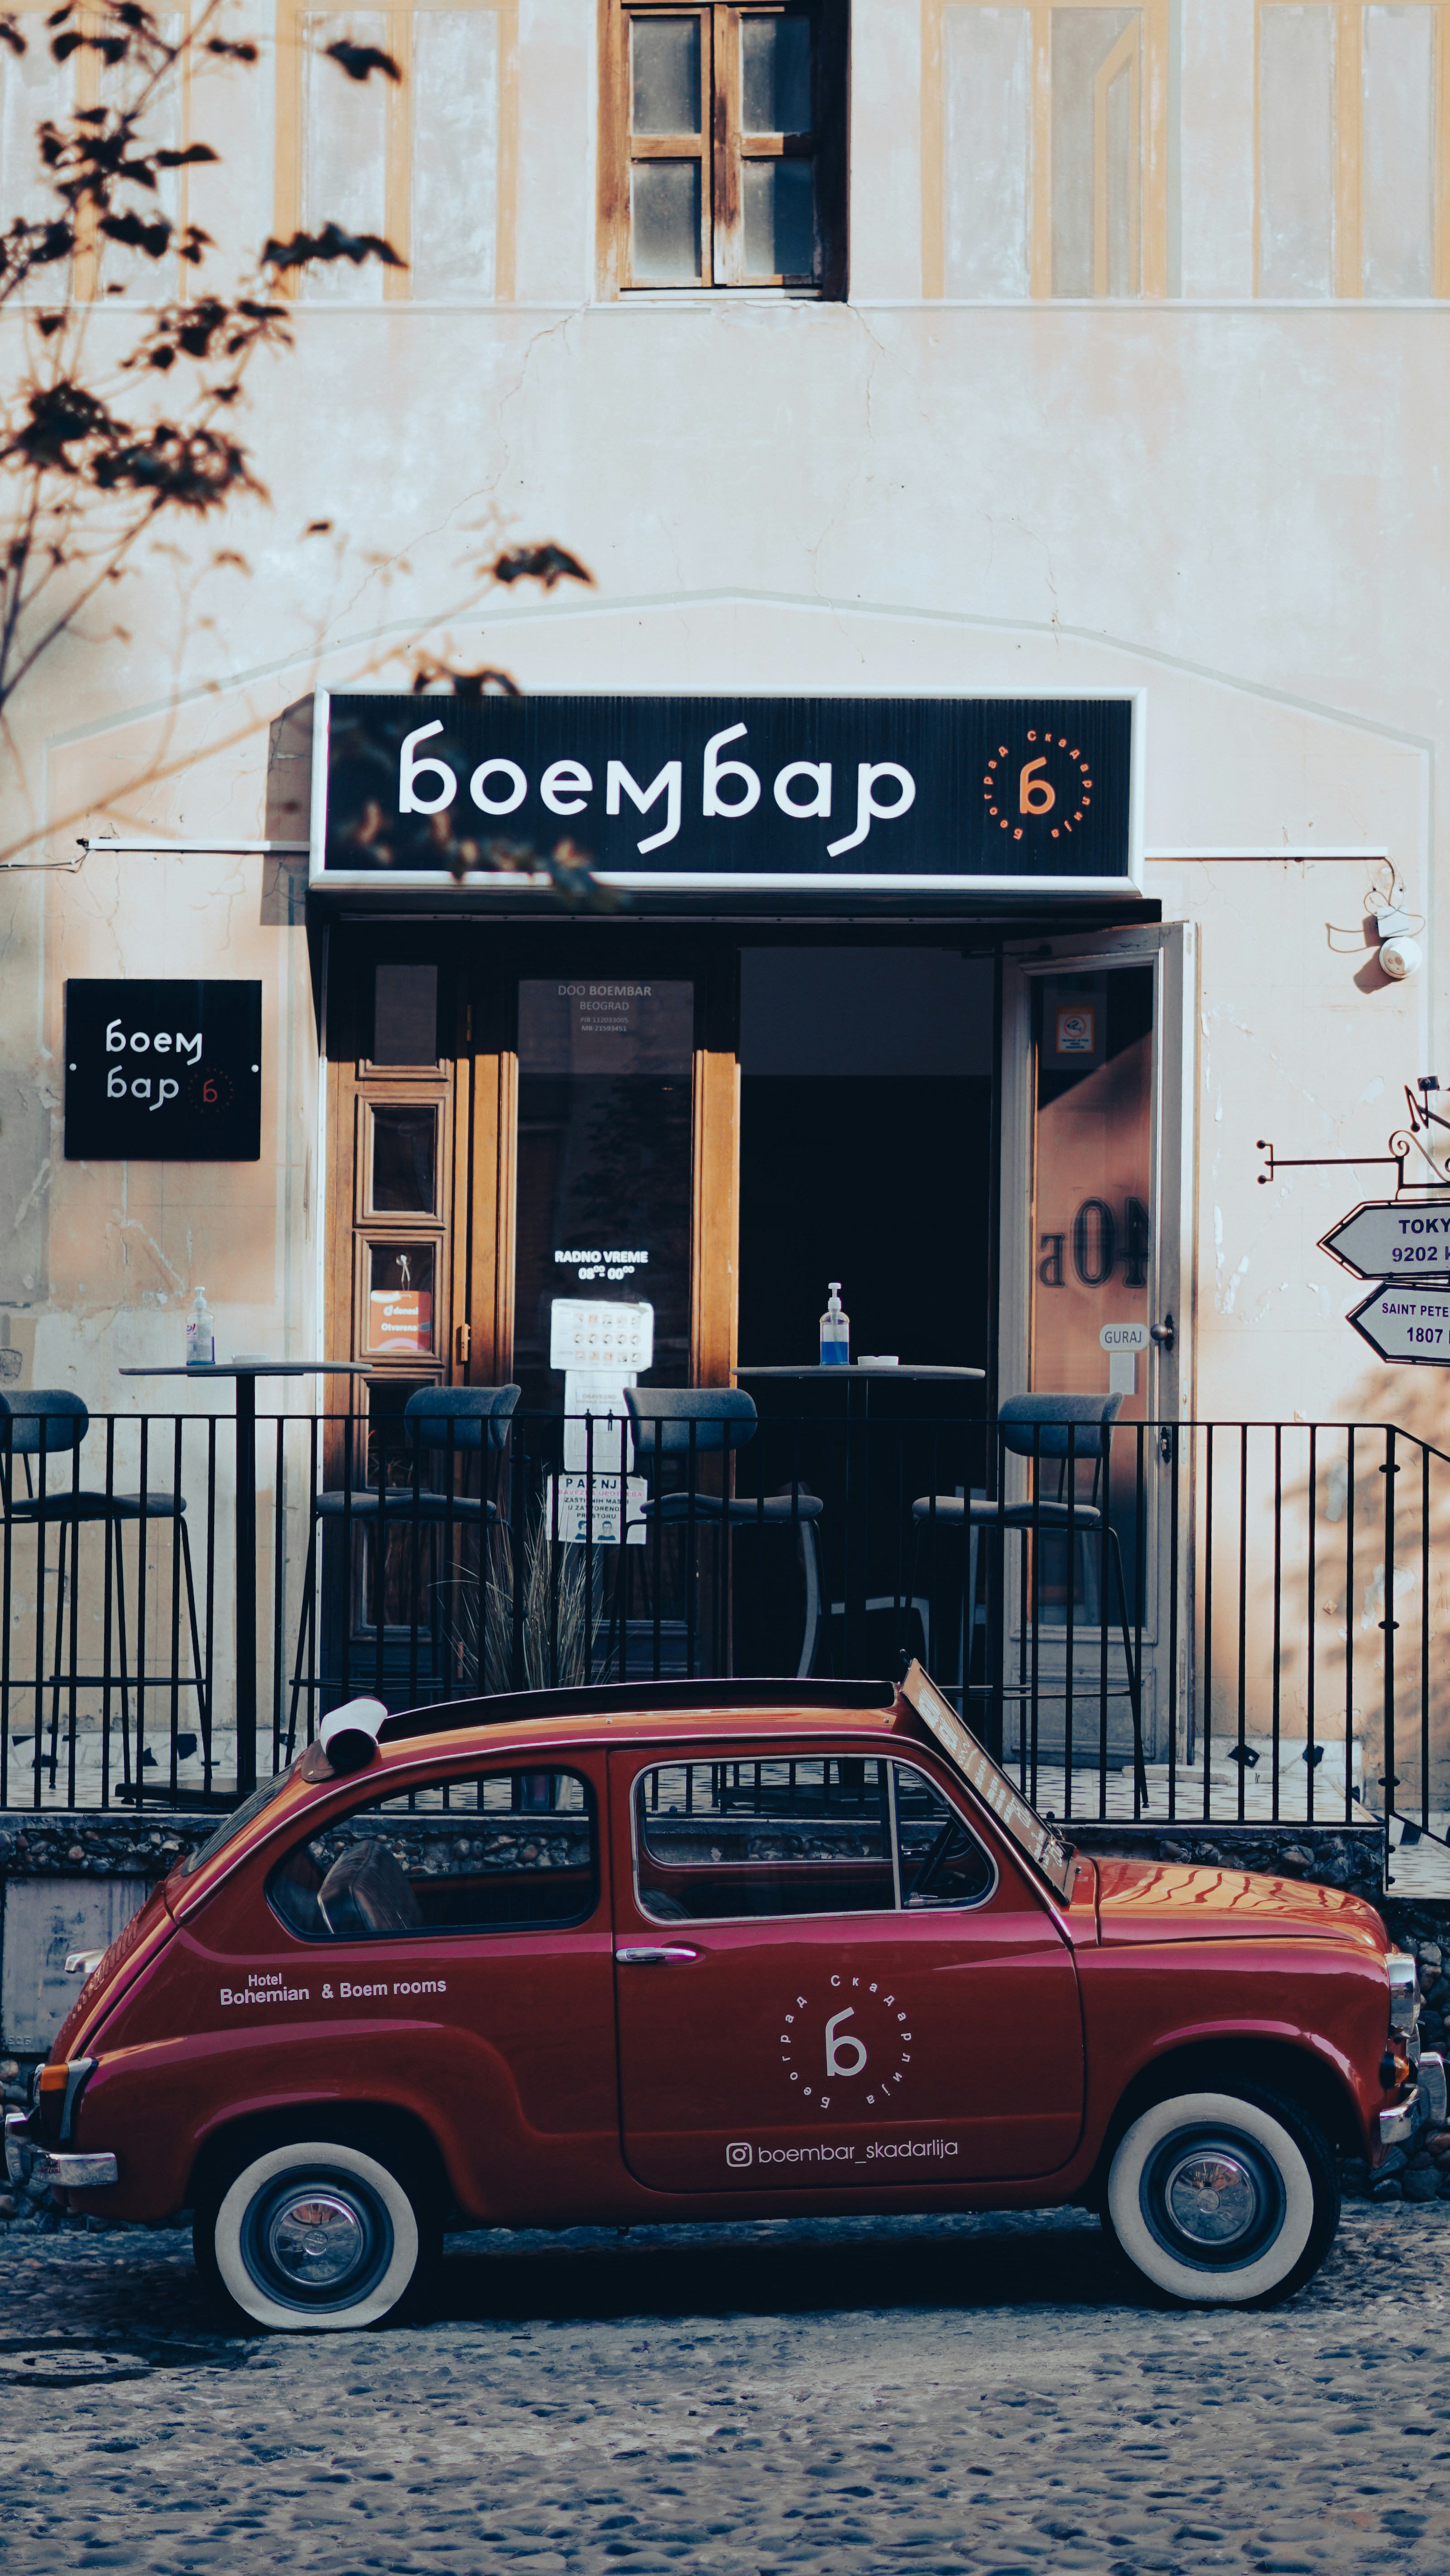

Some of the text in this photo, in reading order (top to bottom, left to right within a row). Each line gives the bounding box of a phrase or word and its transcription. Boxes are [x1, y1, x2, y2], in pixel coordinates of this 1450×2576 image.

[558, 986, 651, 996] DOO BOEMBAR
[580, 1002, 629, 1011] BEOGRAD
[106, 1018, 203, 1066] боем
[107, 1065, 179, 1111] бар
[1398, 1218, 1450, 1234] TOKY
[555, 1250, 649, 1263] RADNO VREME
[1392, 1246, 1437, 1262] 9202
[393, 1306, 419, 1315] donesi
[1382, 1303, 1416, 1315] SAINT
[381, 1323, 417, 1332] Otvoreno
[1407, 1327, 1443, 1344] 1807
[1105, 1331, 1142, 1343] GURAJ
[248, 1972, 282, 1987] Hotel
[220, 1980, 446, 2005] Bohemian & Boem rooms
[830, 1975, 912, 2104] Скадарлија
[780, 1995, 830, 2109] Београд
[758, 2139, 958, 2164] boembar_skadarlija
